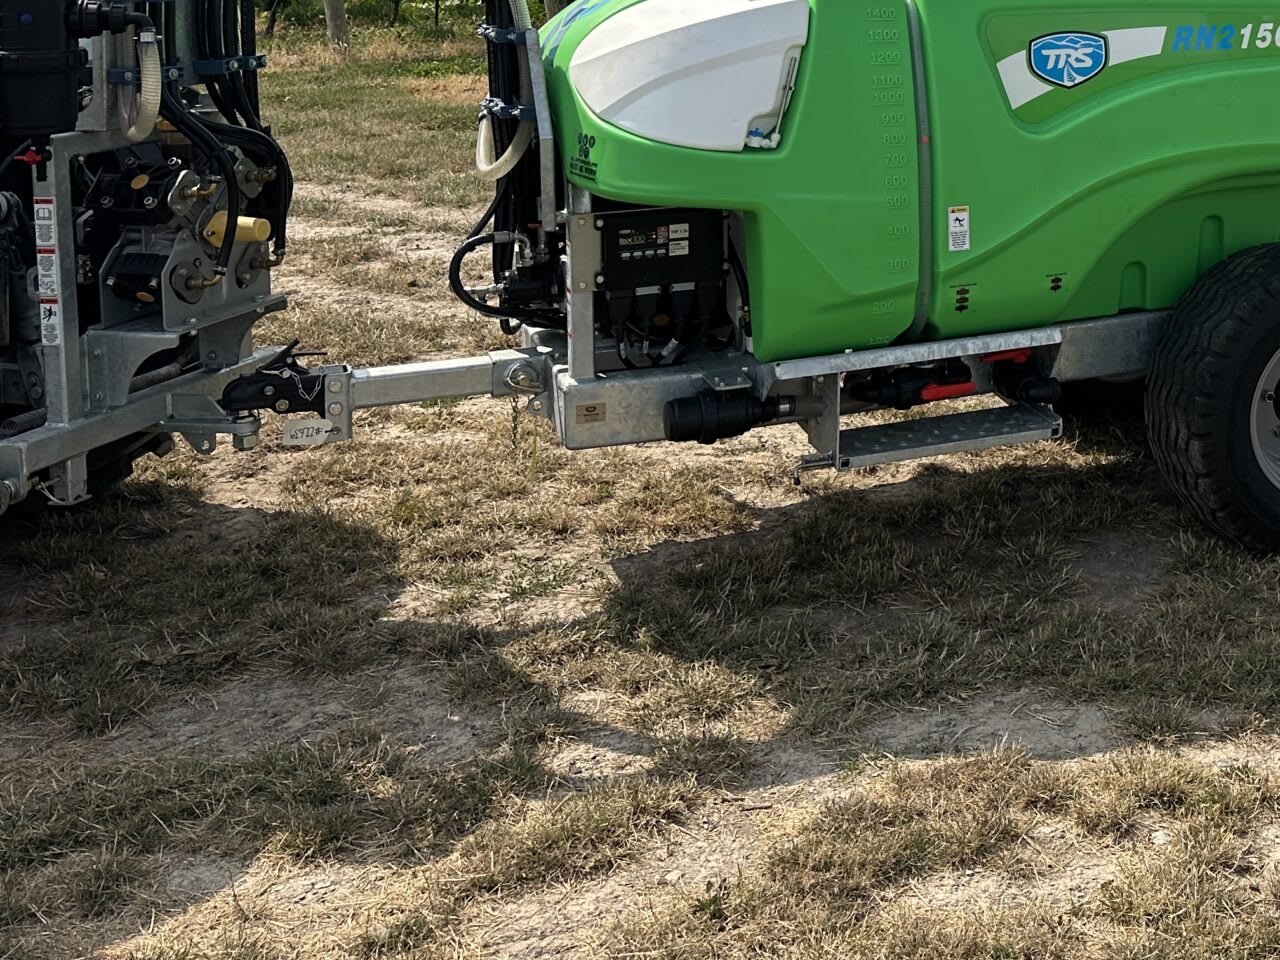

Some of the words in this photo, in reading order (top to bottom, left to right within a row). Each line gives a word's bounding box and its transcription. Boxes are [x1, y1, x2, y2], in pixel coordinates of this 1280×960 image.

[866, 8, 896, 18] 1400
[868, 30, 898, 40] 1300
[1172, 24, 1235, 52] RN2
[871, 52, 900, 62] 1200
[1041, 47, 1094, 70] TRS
[872, 75, 902, 85] 1100
[873, 93, 904, 103] 1000
[881, 113, 905, 123] 900
[883, 134, 905, 144] 800
[884, 154, 907, 164] 700
[885, 176, 908, 186] 600
[886, 196, 909, 207] 500
[887, 225, 909, 235] 400
[887, 260, 909, 270] 300
[873, 301, 896, 312] 200
